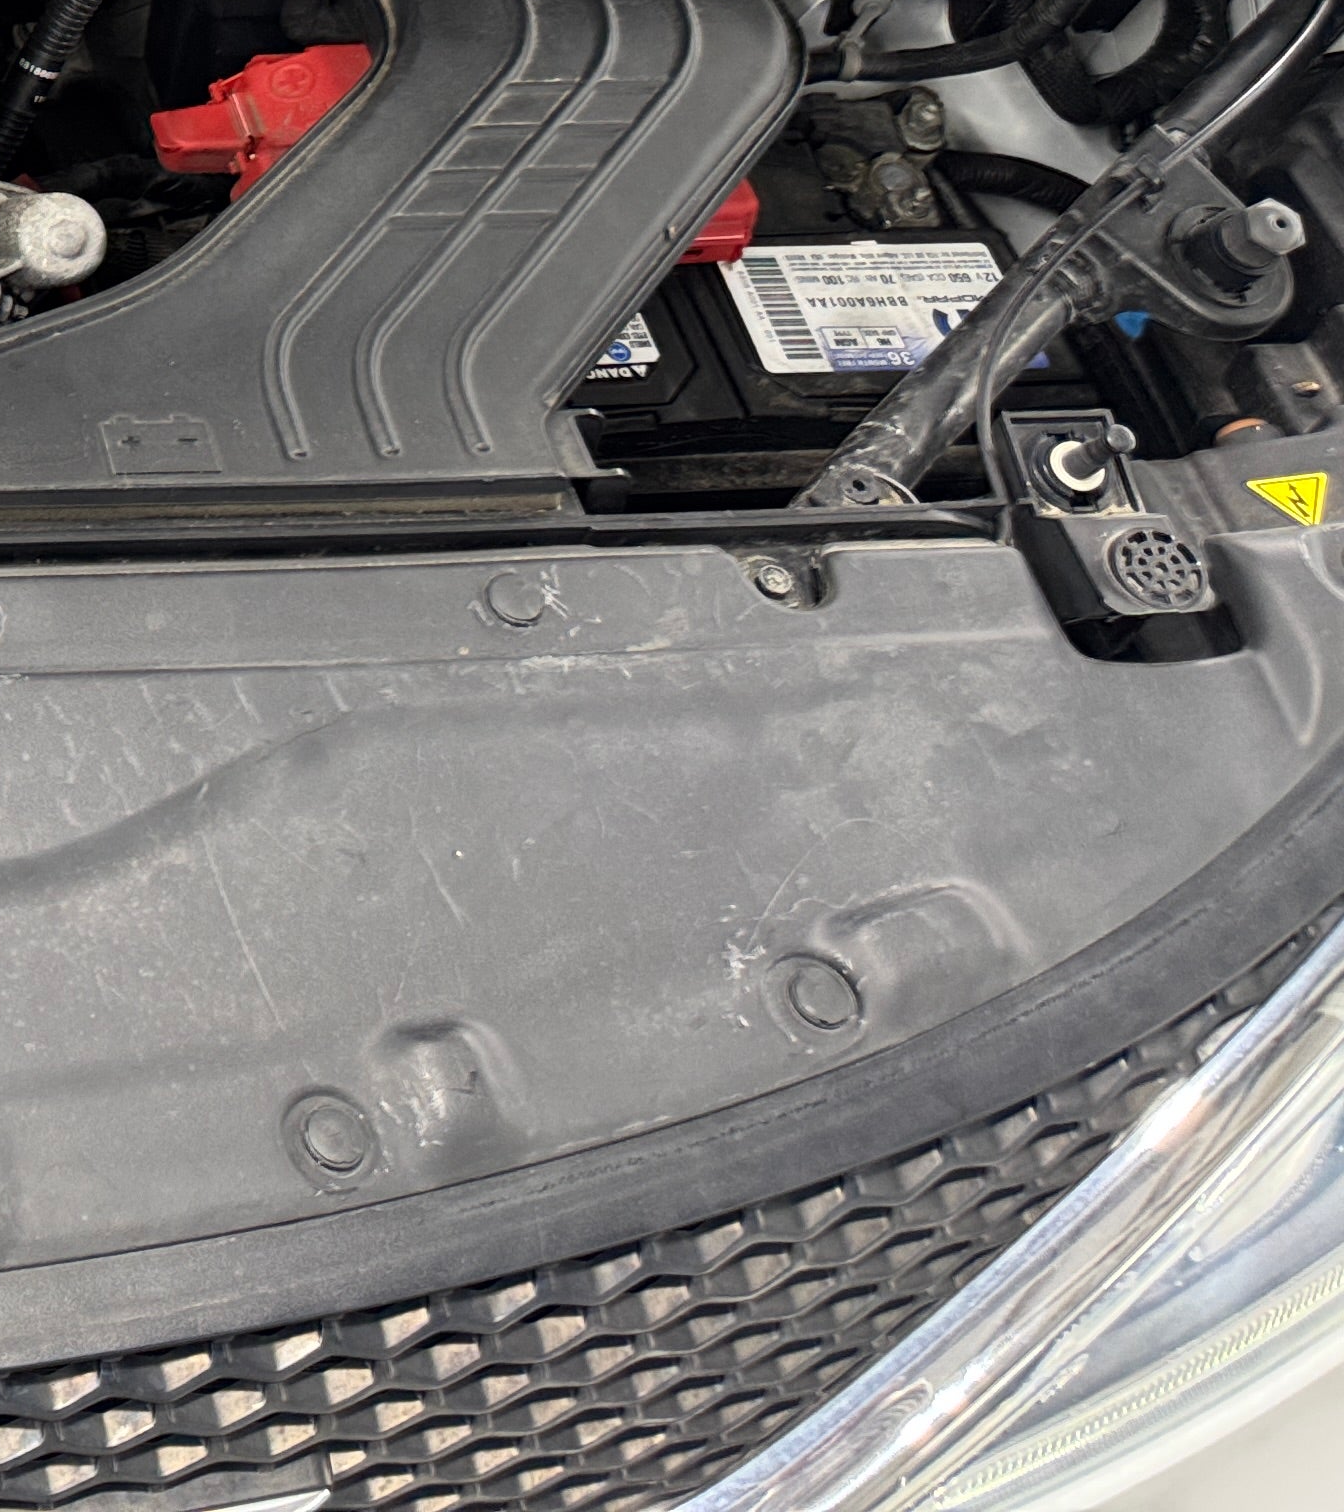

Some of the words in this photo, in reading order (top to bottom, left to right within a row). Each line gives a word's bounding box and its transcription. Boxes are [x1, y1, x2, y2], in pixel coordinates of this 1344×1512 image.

[821, 275, 846, 286] 100
[879, 274, 897, 285] 70
[948, 273, 972, 283] 650
[805, 296, 909, 309] BBH6A001AA
[886, 351, 916, 366] 36
